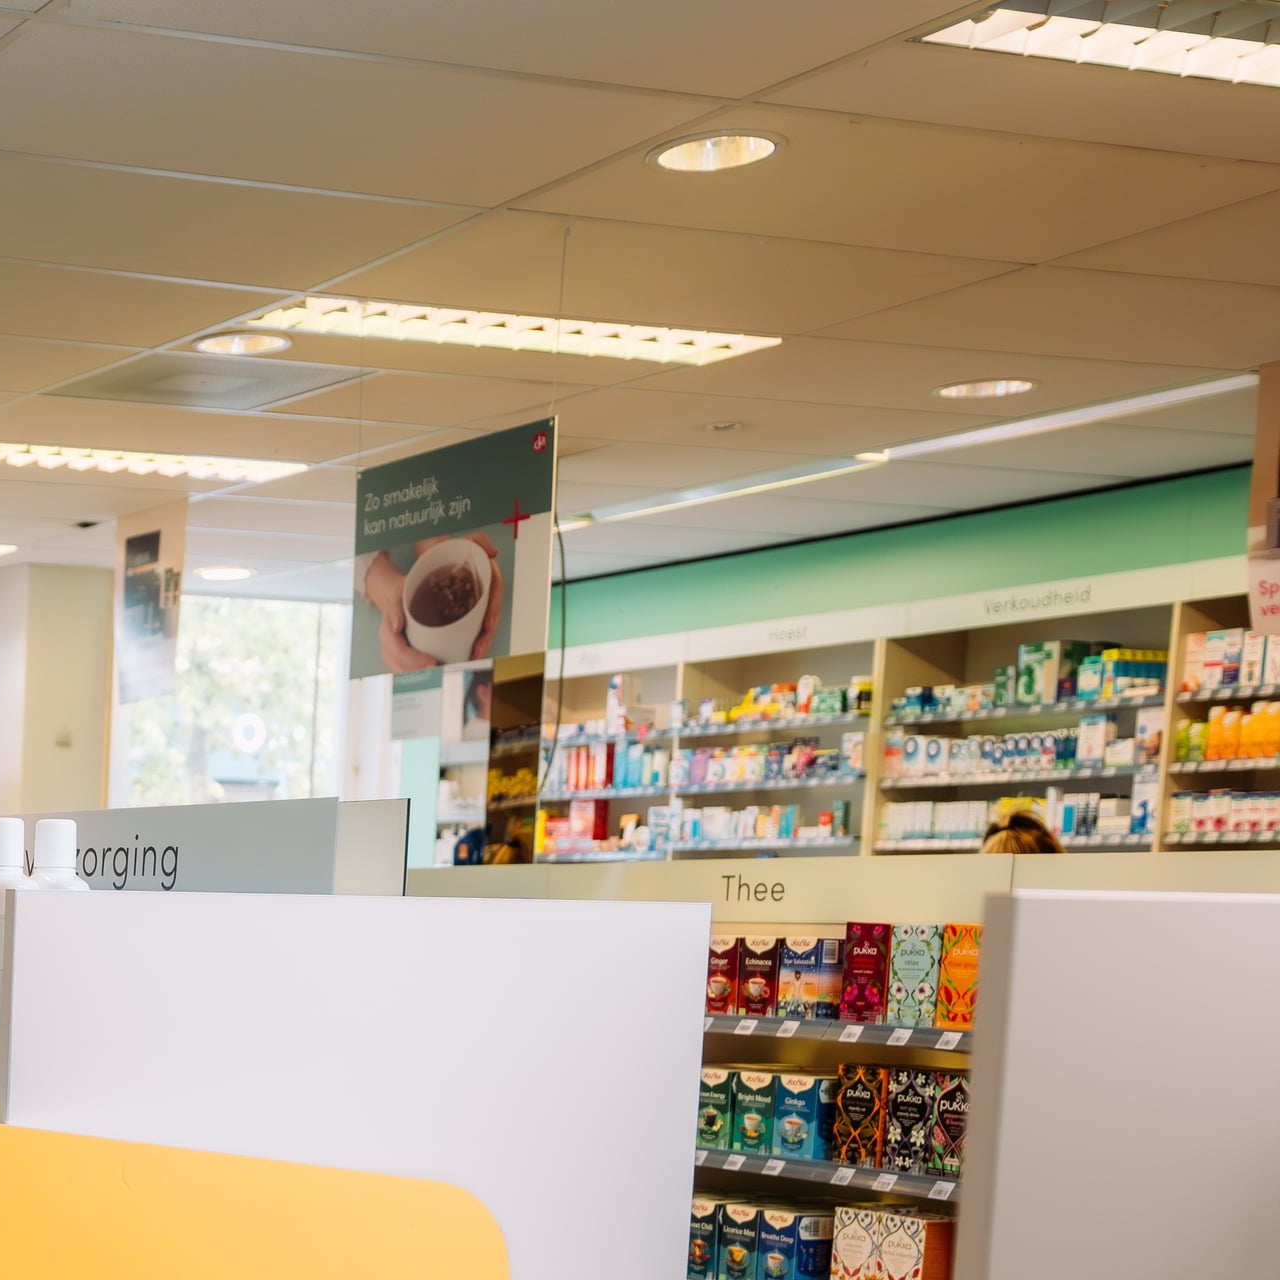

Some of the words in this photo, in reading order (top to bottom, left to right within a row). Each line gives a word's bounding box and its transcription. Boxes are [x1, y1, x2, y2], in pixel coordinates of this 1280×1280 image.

[365, 493, 379, 511] Zo
[383, 475, 439, 507] smakelijk
[363, 517, 386, 536] kan
[389, 501, 446, 530] natuurlijk
[448, 496, 471, 520] zijn
[984, 584, 1092, 614] Verkoudheid
[721, 874, 785, 902] Thee
[853, 947, 877, 956] pukka
[901, 949, 925, 957] pukka
[710, 957, 728, 965] Ginger
[745, 957, 772, 966] Echinacea
[711, 1091, 726, 1100] Energy
[738, 1092, 754, 1102] Bright
[756, 1094, 772, 1103] Mood
[847, 1089, 871, 1099] pukka
[785, 1097, 806, 1107] Ginkgo
[897, 1094, 922, 1105] pukka
[701, 1222, 713, 1231] Chili
[723, 1225, 742, 1236] Licorice
[743, 1228, 755, 1237] Mint
[761, 1231, 779, 1241] Breathe
[780, 1234, 794, 1244] Deep
[843, 1232, 866, 1243] pukka
[888, 1240, 912, 1250] pukka
